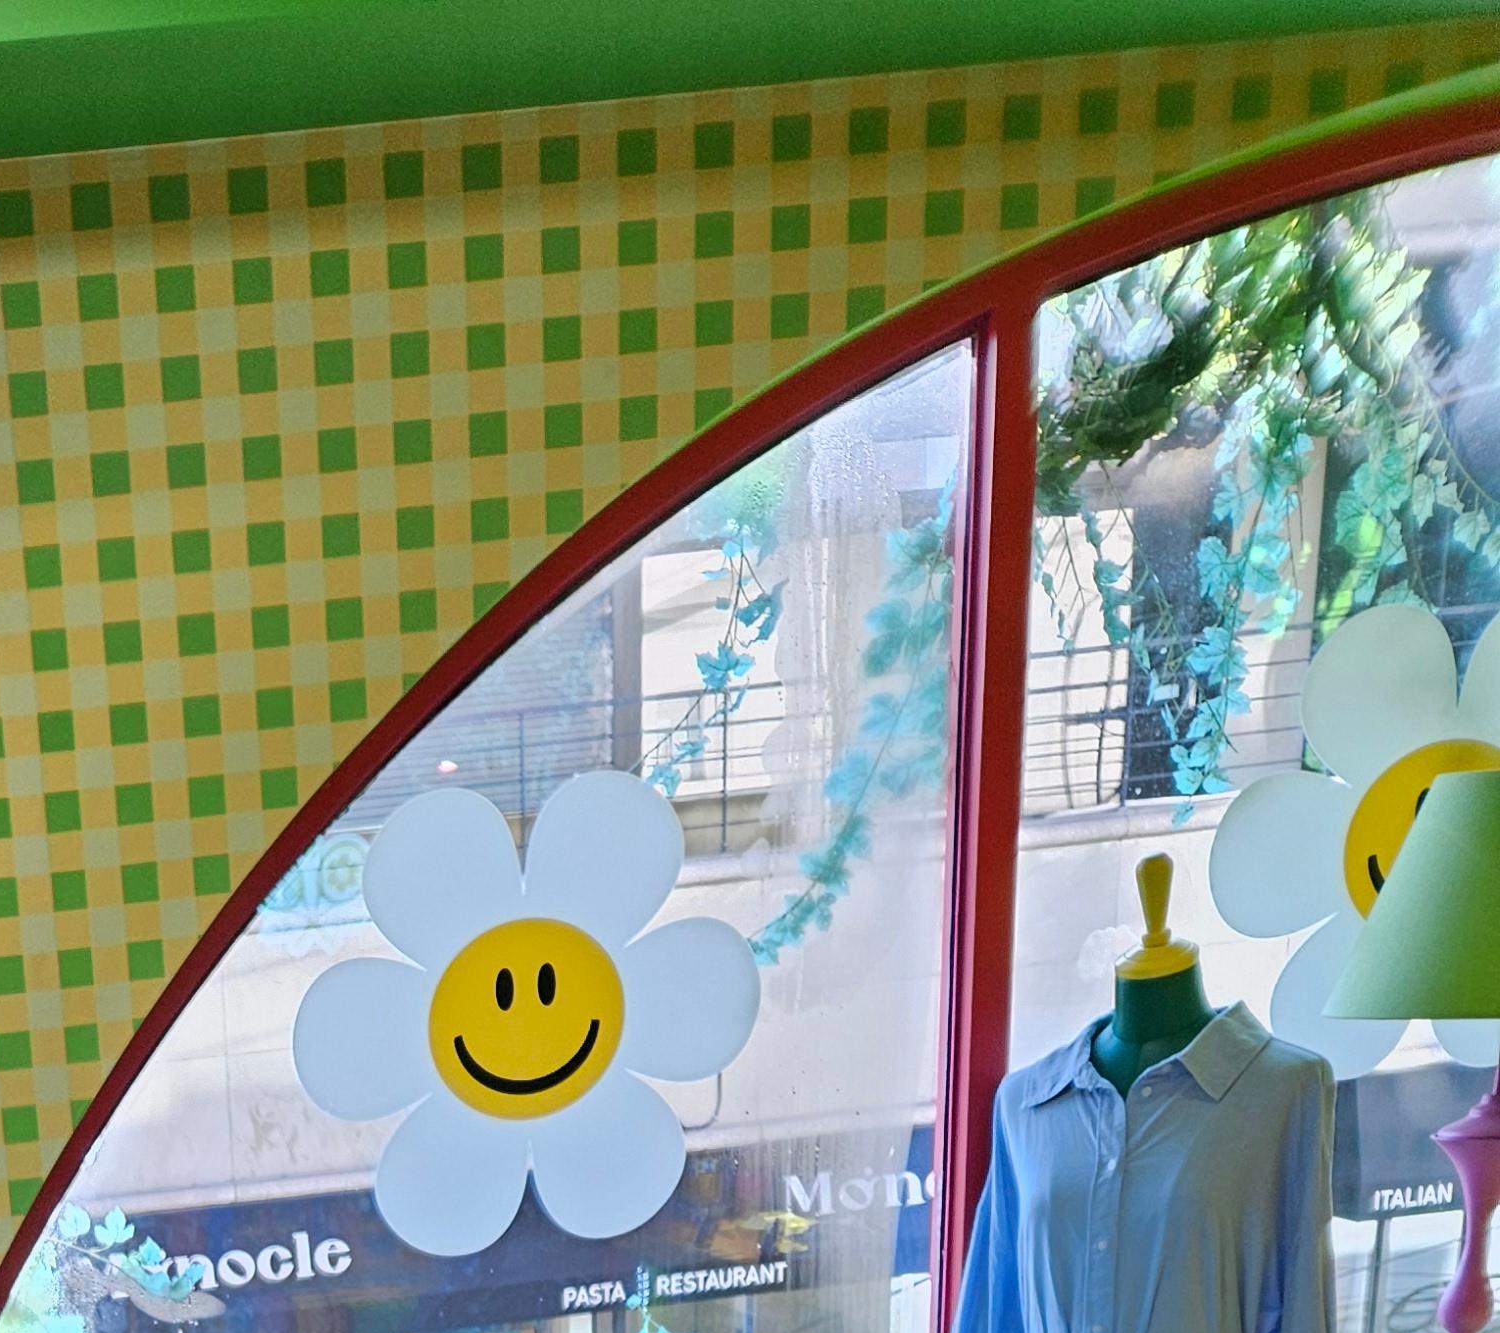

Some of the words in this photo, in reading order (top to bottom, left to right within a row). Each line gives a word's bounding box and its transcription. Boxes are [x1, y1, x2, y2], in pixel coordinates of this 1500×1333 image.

[1373, 1181, 1454, 1211] ITALIAN
[562, 1280, 627, 1311] PASTA
[655, 1261, 789, 1297] RESTAURANT
